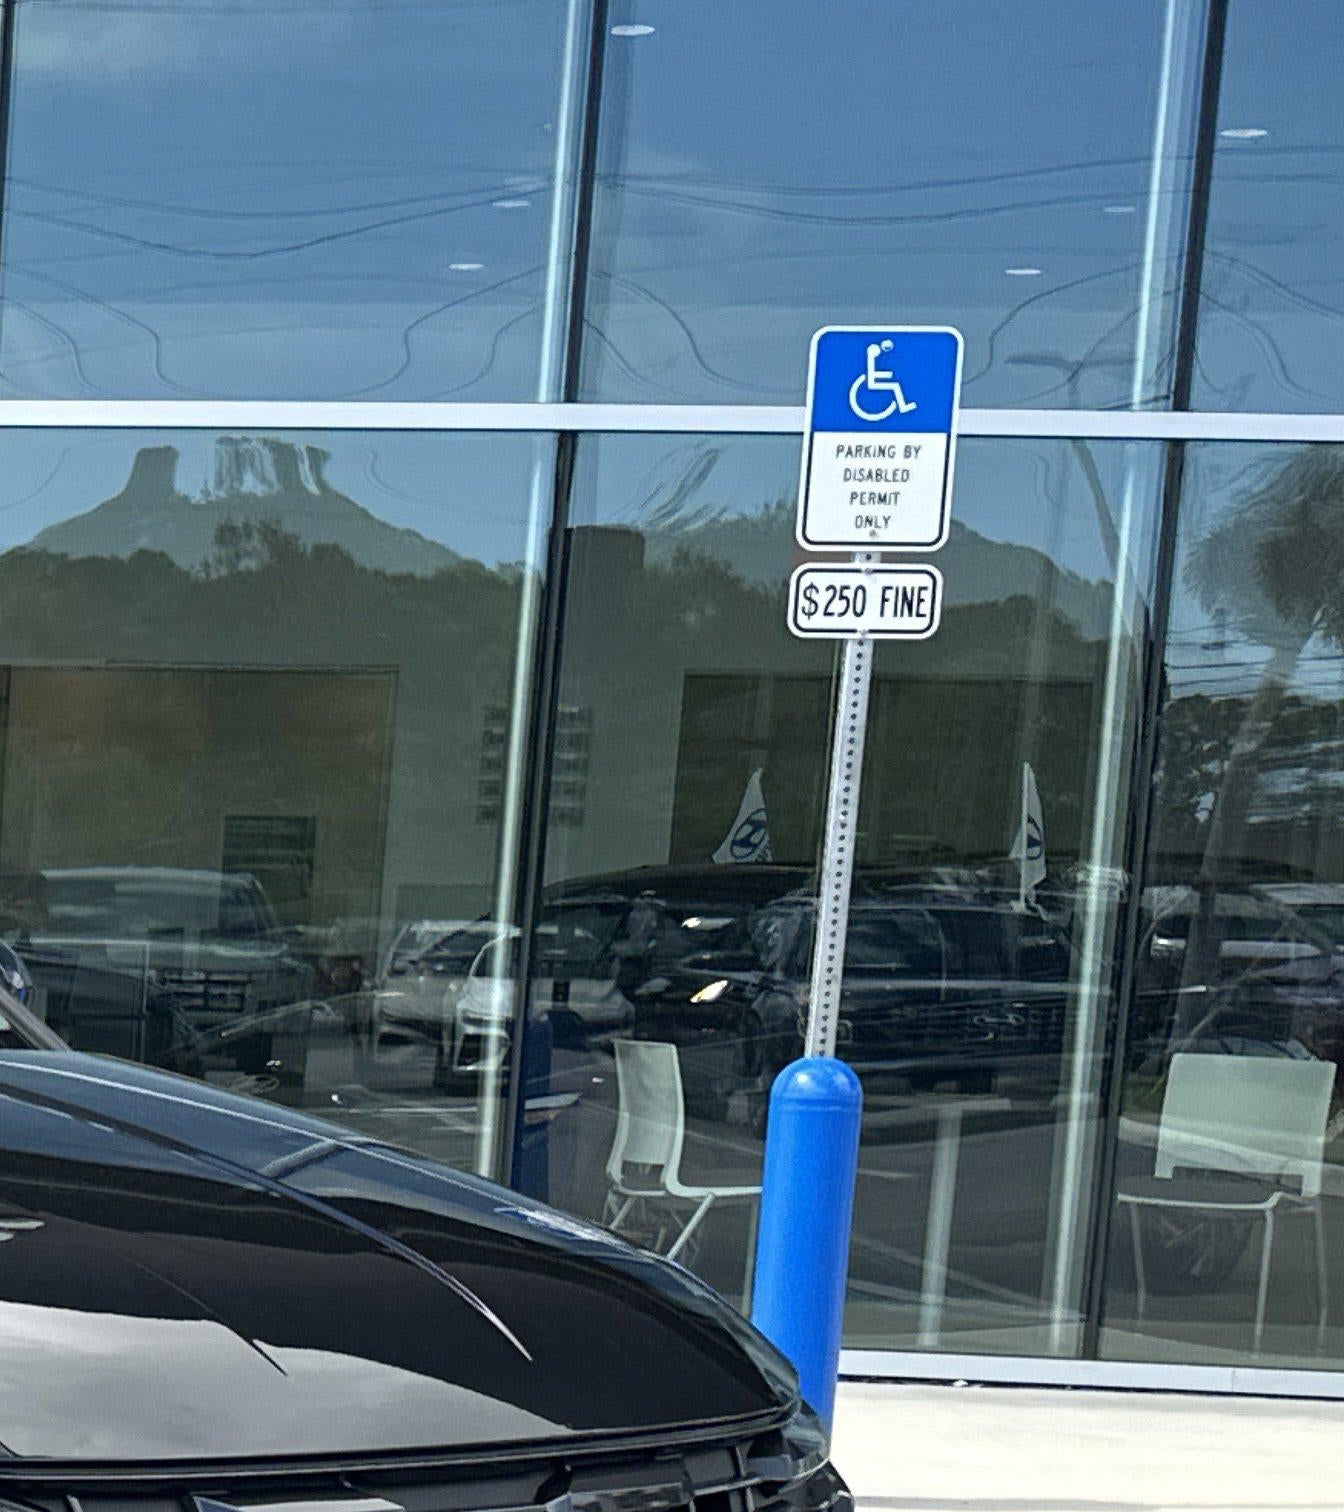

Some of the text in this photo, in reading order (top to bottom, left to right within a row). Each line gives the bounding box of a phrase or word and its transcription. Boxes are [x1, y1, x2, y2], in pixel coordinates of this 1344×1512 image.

[836, 444, 922, 459] PARKING BY
[843, 468, 910, 483] DISABLED
[849, 491, 900, 507] PERMIT
[854, 514, 892, 530] ONLY
[801, 582, 929, 620] $250 FINE
